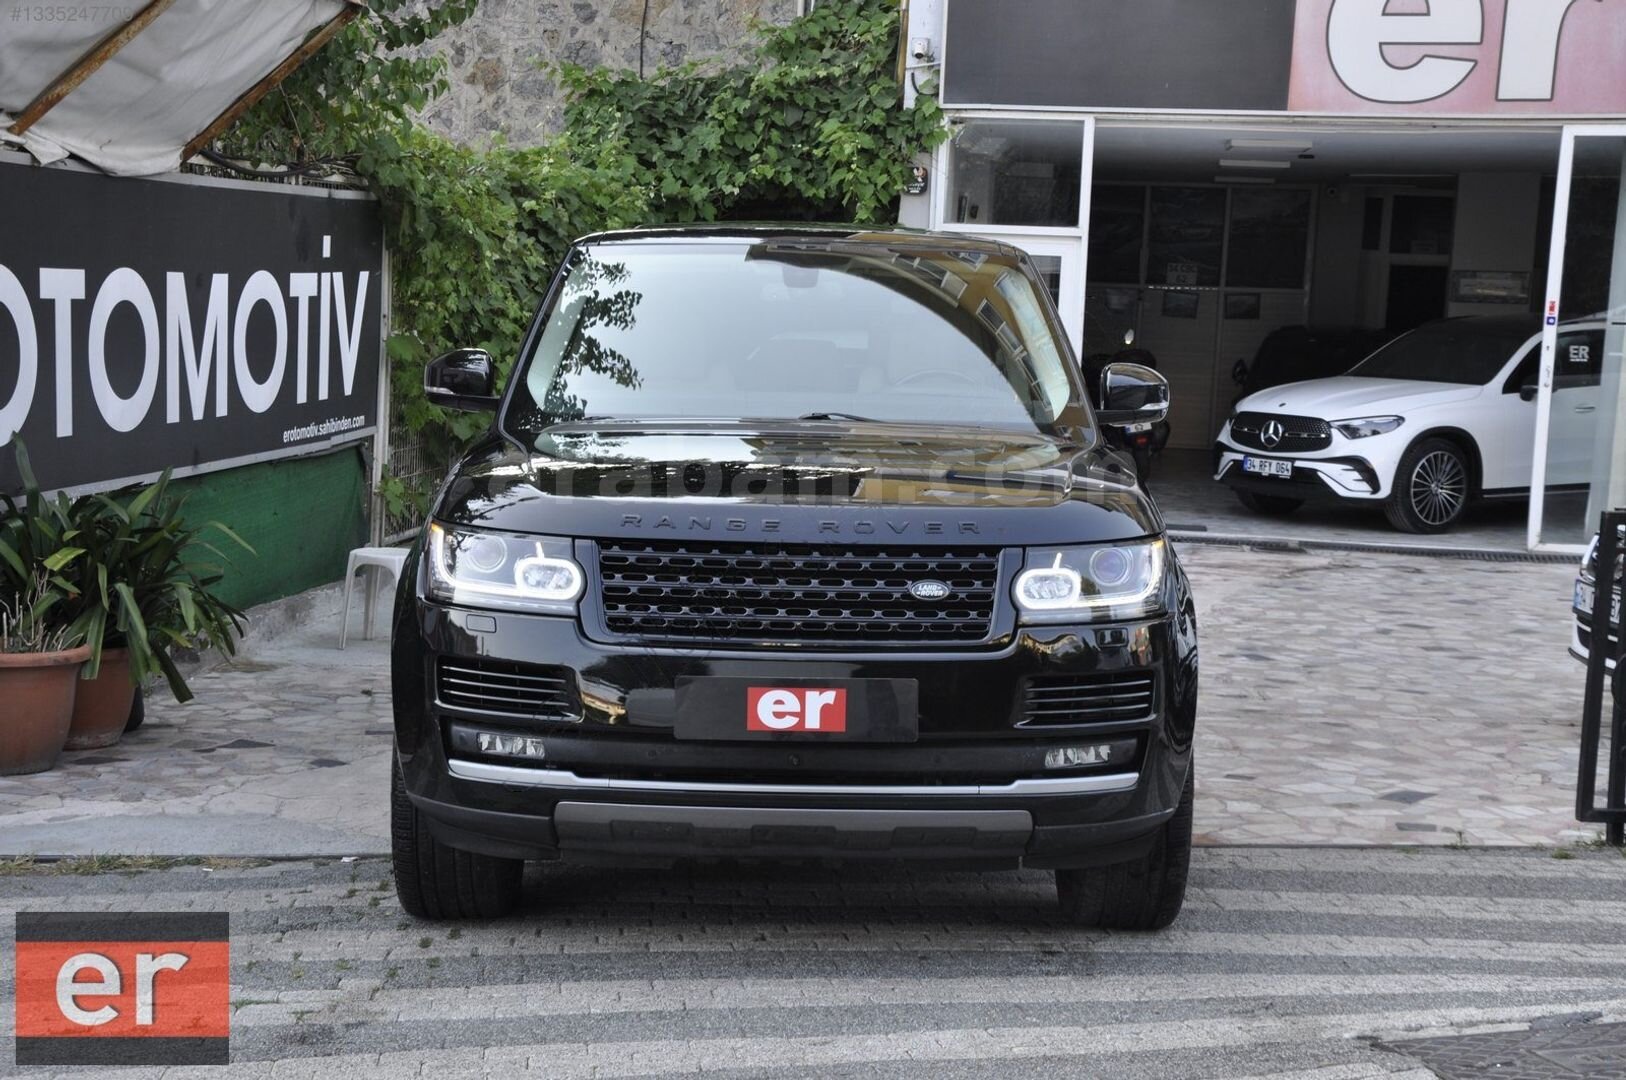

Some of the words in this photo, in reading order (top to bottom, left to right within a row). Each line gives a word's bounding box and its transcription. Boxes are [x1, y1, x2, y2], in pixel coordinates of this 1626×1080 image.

[1325, 0, 1577, 104] er
[1569, 345, 1590, 359] ER
[283, 415, 365, 443] erotomotiv.sahibinden.com
[1247, 458, 1256, 470] 34
[620, 513, 781, 533] RANGE
[818, 520, 981, 535] ROVER
[757, 689, 837, 729] er
